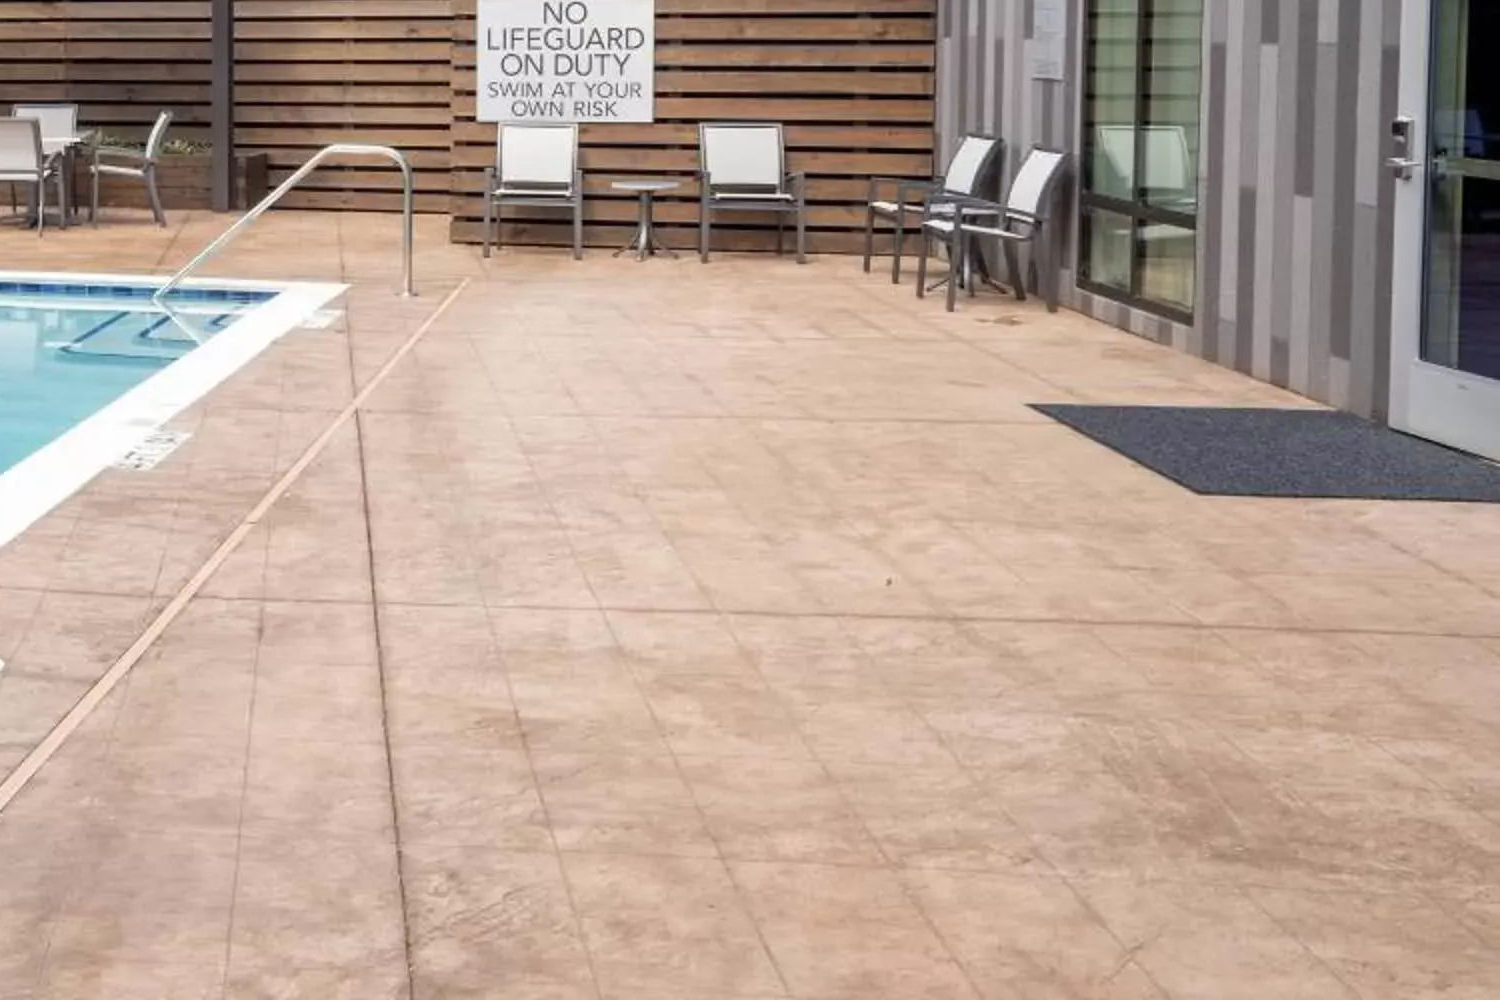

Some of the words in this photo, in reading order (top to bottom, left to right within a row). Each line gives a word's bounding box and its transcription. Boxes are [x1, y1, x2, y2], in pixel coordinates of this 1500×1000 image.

[543, 1, 588, 25] NO
[486, 27, 645, 51] LIFEGUARD
[500, 53, 544, 76] ON
[554, 53, 632, 76] DUTY
[487, 82, 543, 99] SWIM
[551, 82, 576, 98] AT
[583, 81, 642, 98] YOUR
[511, 101, 564, 117] OWN
[573, 101, 618, 117] RISK
